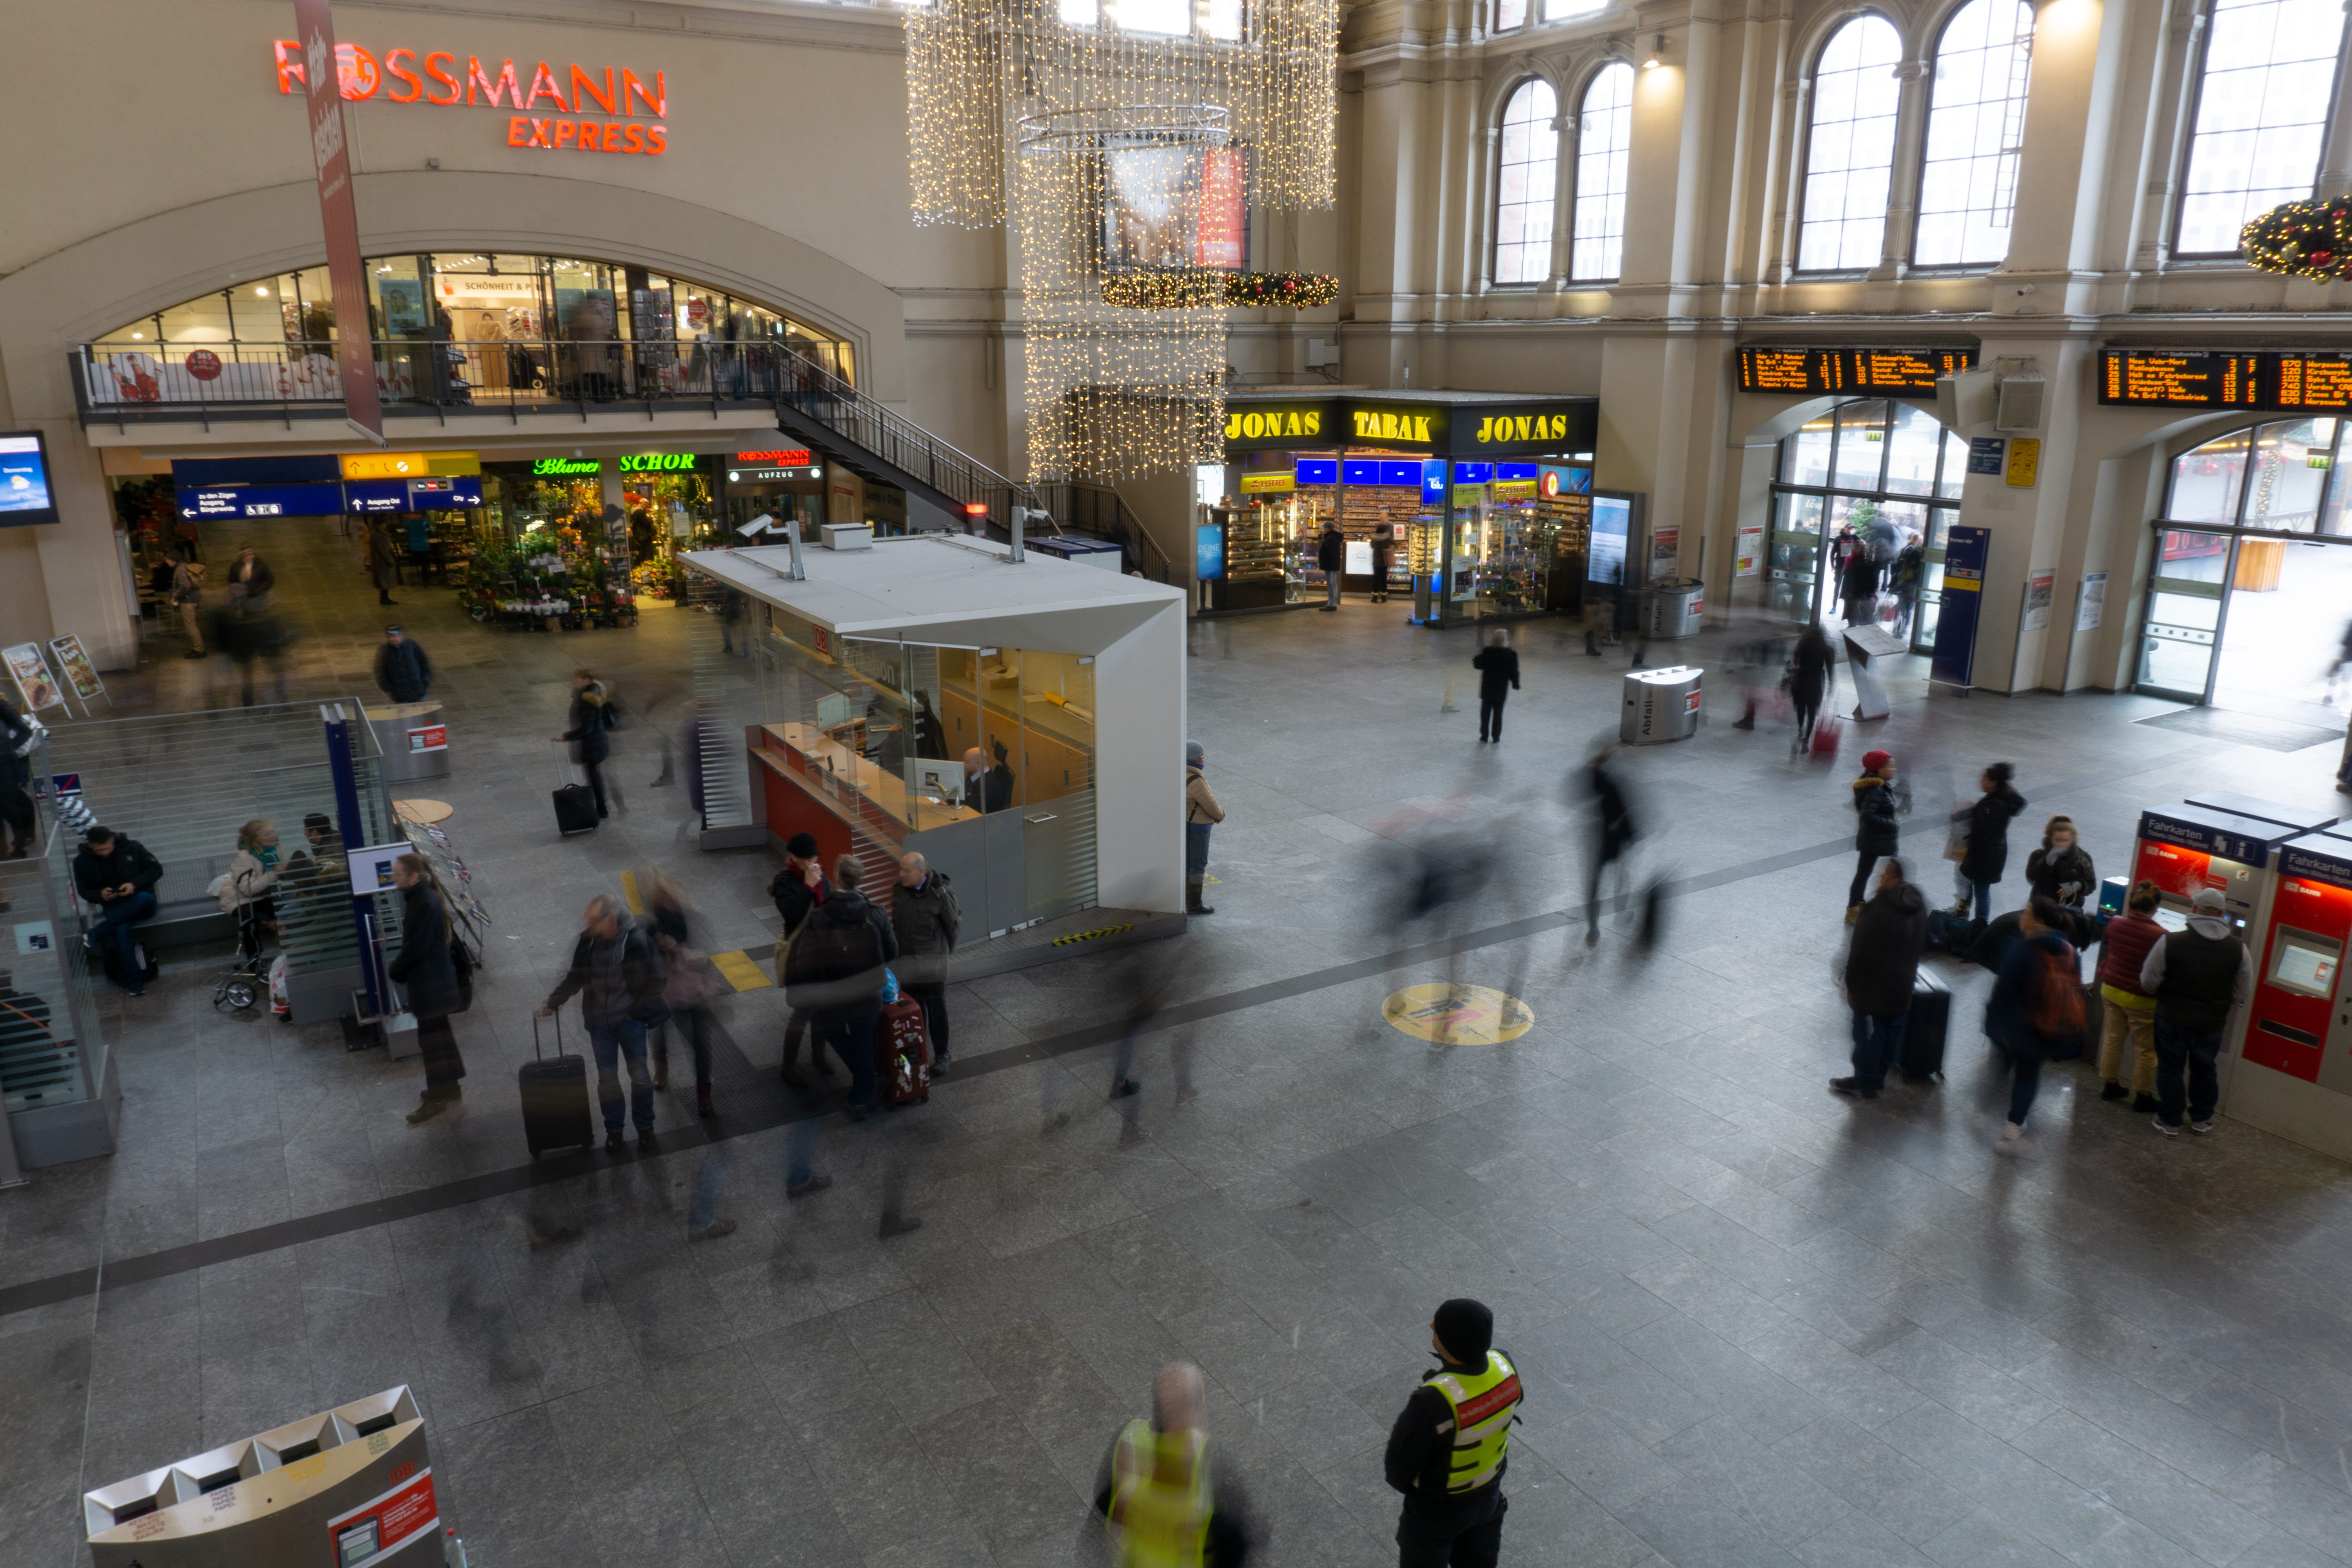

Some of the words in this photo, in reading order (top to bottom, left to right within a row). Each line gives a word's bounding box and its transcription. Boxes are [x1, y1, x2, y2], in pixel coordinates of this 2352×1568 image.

[274, 40, 666, 118] ROSSMANN
[508, 116, 667, 154] EXPRESS
[465, 281, 514, 290] SCHÖNHEIT
[1225, 412, 1320, 439] JONAS
[1354, 412, 1431, 442] TABAK
[1477, 415, 1566, 443] JONAS
[738, 450, 809, 461] ROSSMANN
[620, 454, 695, 471] SCHOR
[1430, 480, 1443, 490] blu
[1506, 485, 1528, 494] LOTTO
[1198, 543, 1220, 552] DEINE
[1654, 605, 1662, 632] Abfall
[1642, 701, 1653, 735] Abfall
[2149, 819, 2202, 840] Fahrkarten
[2159, 851, 2178, 860] BAHN
[2289, 853, 2350, 877] Fahrkarten
[2299, 887, 2321, 897] BAHN
[391, 1462, 414, 1483] DB
[210, 1486, 234, 1497] PAPIER
[212, 1495, 236, 1506] PAPIER
[214, 1503, 236, 1512] PAPEL
[136, 1518, 159, 1529] WASTE
[135, 1527, 165, 1541] BASURA
